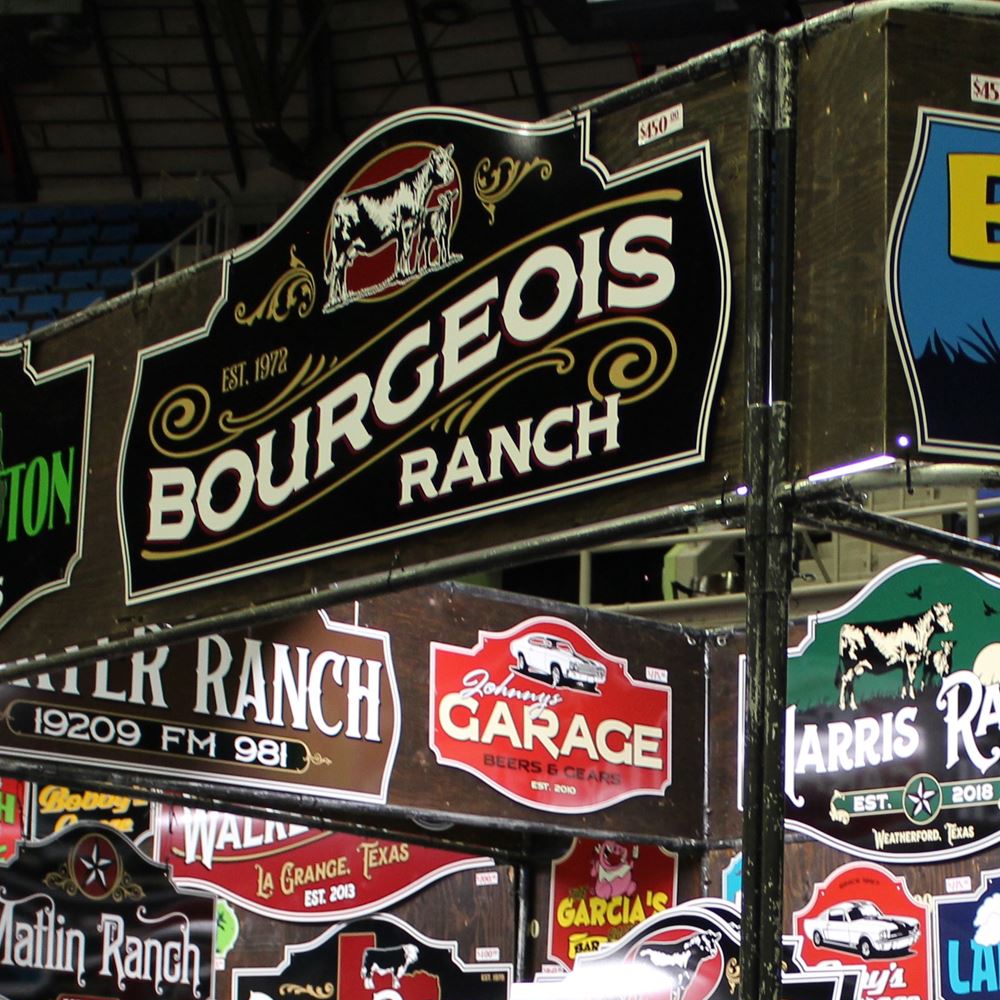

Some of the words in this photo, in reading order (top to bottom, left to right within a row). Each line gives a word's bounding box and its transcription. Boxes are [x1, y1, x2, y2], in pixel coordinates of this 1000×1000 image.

[146, 216, 675, 543] BOURGEOIS
[222, 361, 250, 393] EST.
[399, 393, 621, 506] RANCH
[194, 634, 382, 742] RANCH
[34, 707, 142, 748] 19209
[161, 724, 217, 758] FM
[234, 736, 288, 768] 981
[438, 693, 664, 770] GARAGE
[483, 754, 542, 776] BEERS
[564, 765, 622, 786] GEARS
[852, 793, 892, 813] EST.
[951, 782, 994, 804] 2018
[872, 827, 942, 850] WEATHERFORD,
[944, 822, 975, 845] TEXAS
[356, 842, 410, 880] TEXAS
[304, 888, 326, 908] EST.
[330, 883, 356, 903] 2013
[557, 890, 669, 928] GARCIA'S
[97, 905, 201, 999] Ranch
